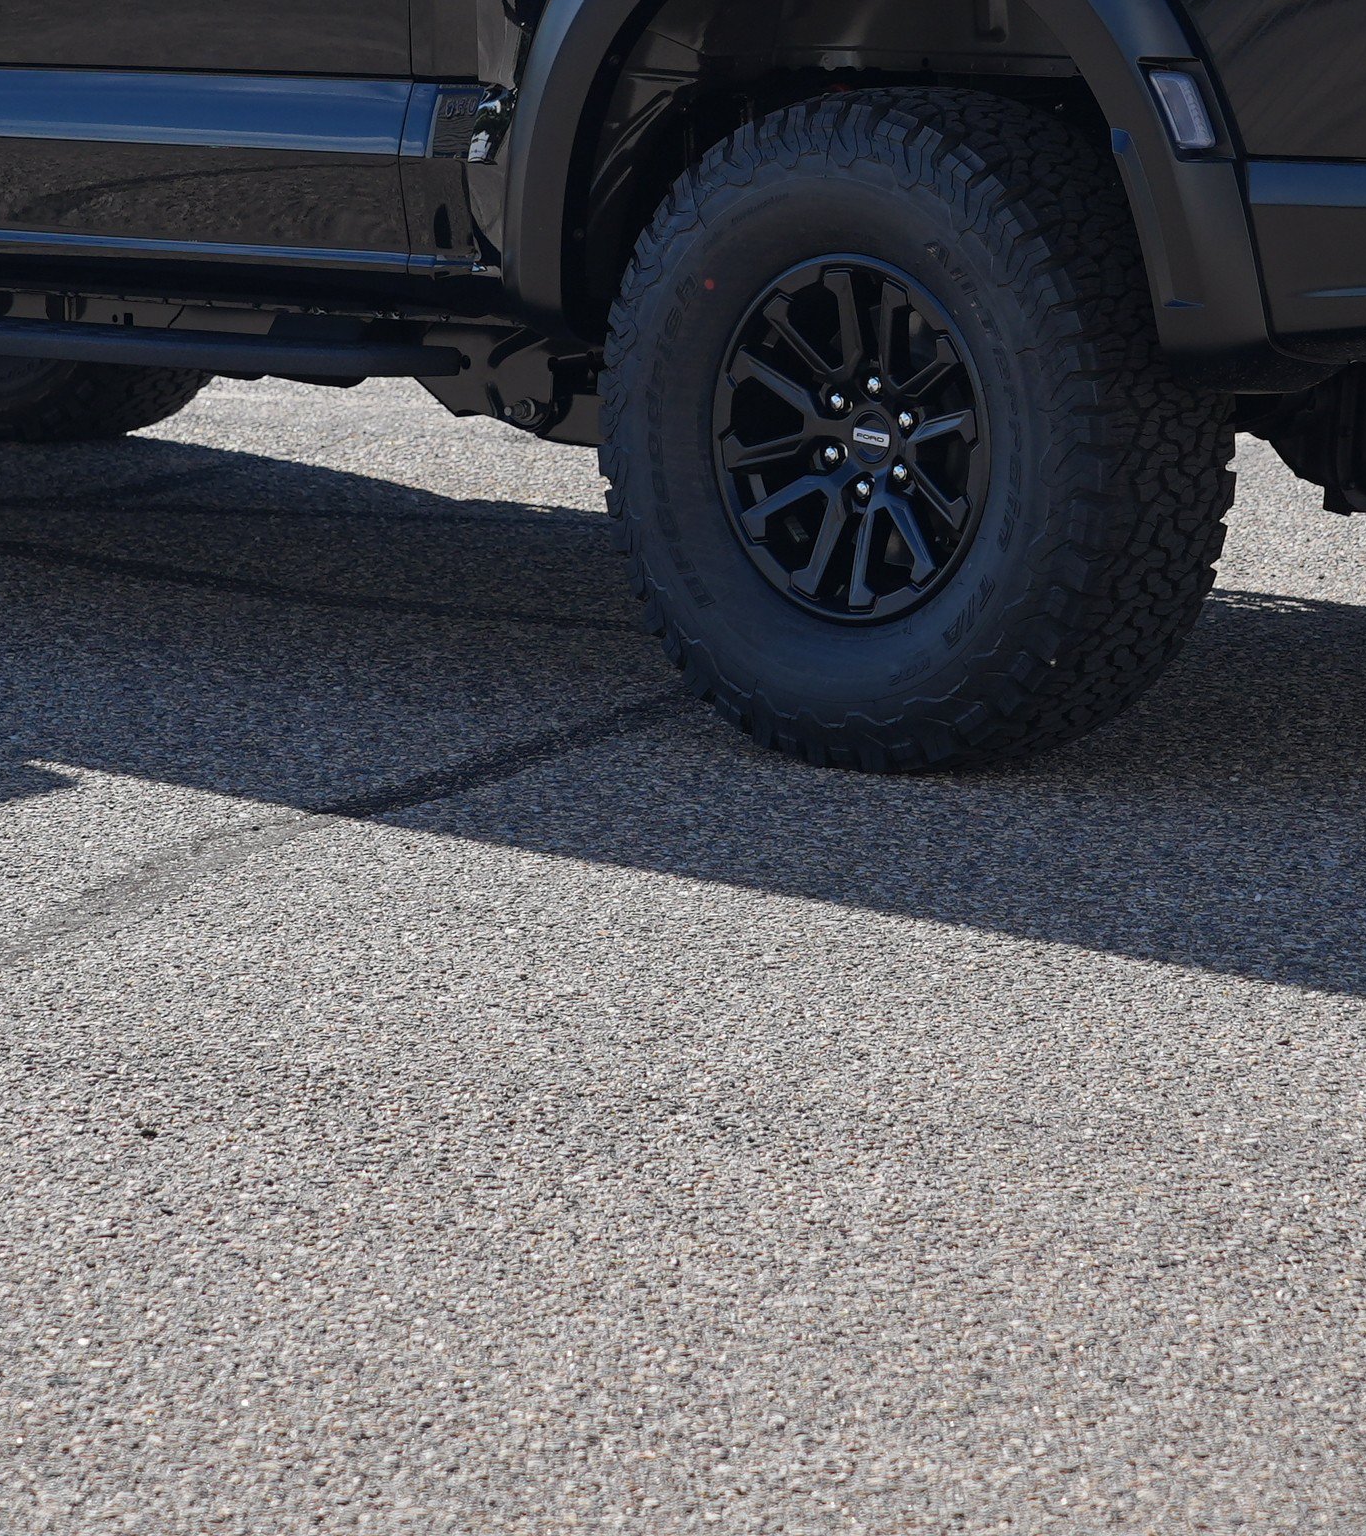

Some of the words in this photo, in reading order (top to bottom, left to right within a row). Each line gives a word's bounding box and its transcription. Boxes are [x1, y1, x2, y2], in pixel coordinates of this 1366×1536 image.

[921, 238, 1026, 554] All-Terrain
[856, 432, 885, 443] FORD
[939, 573, 998, 651] T/A
